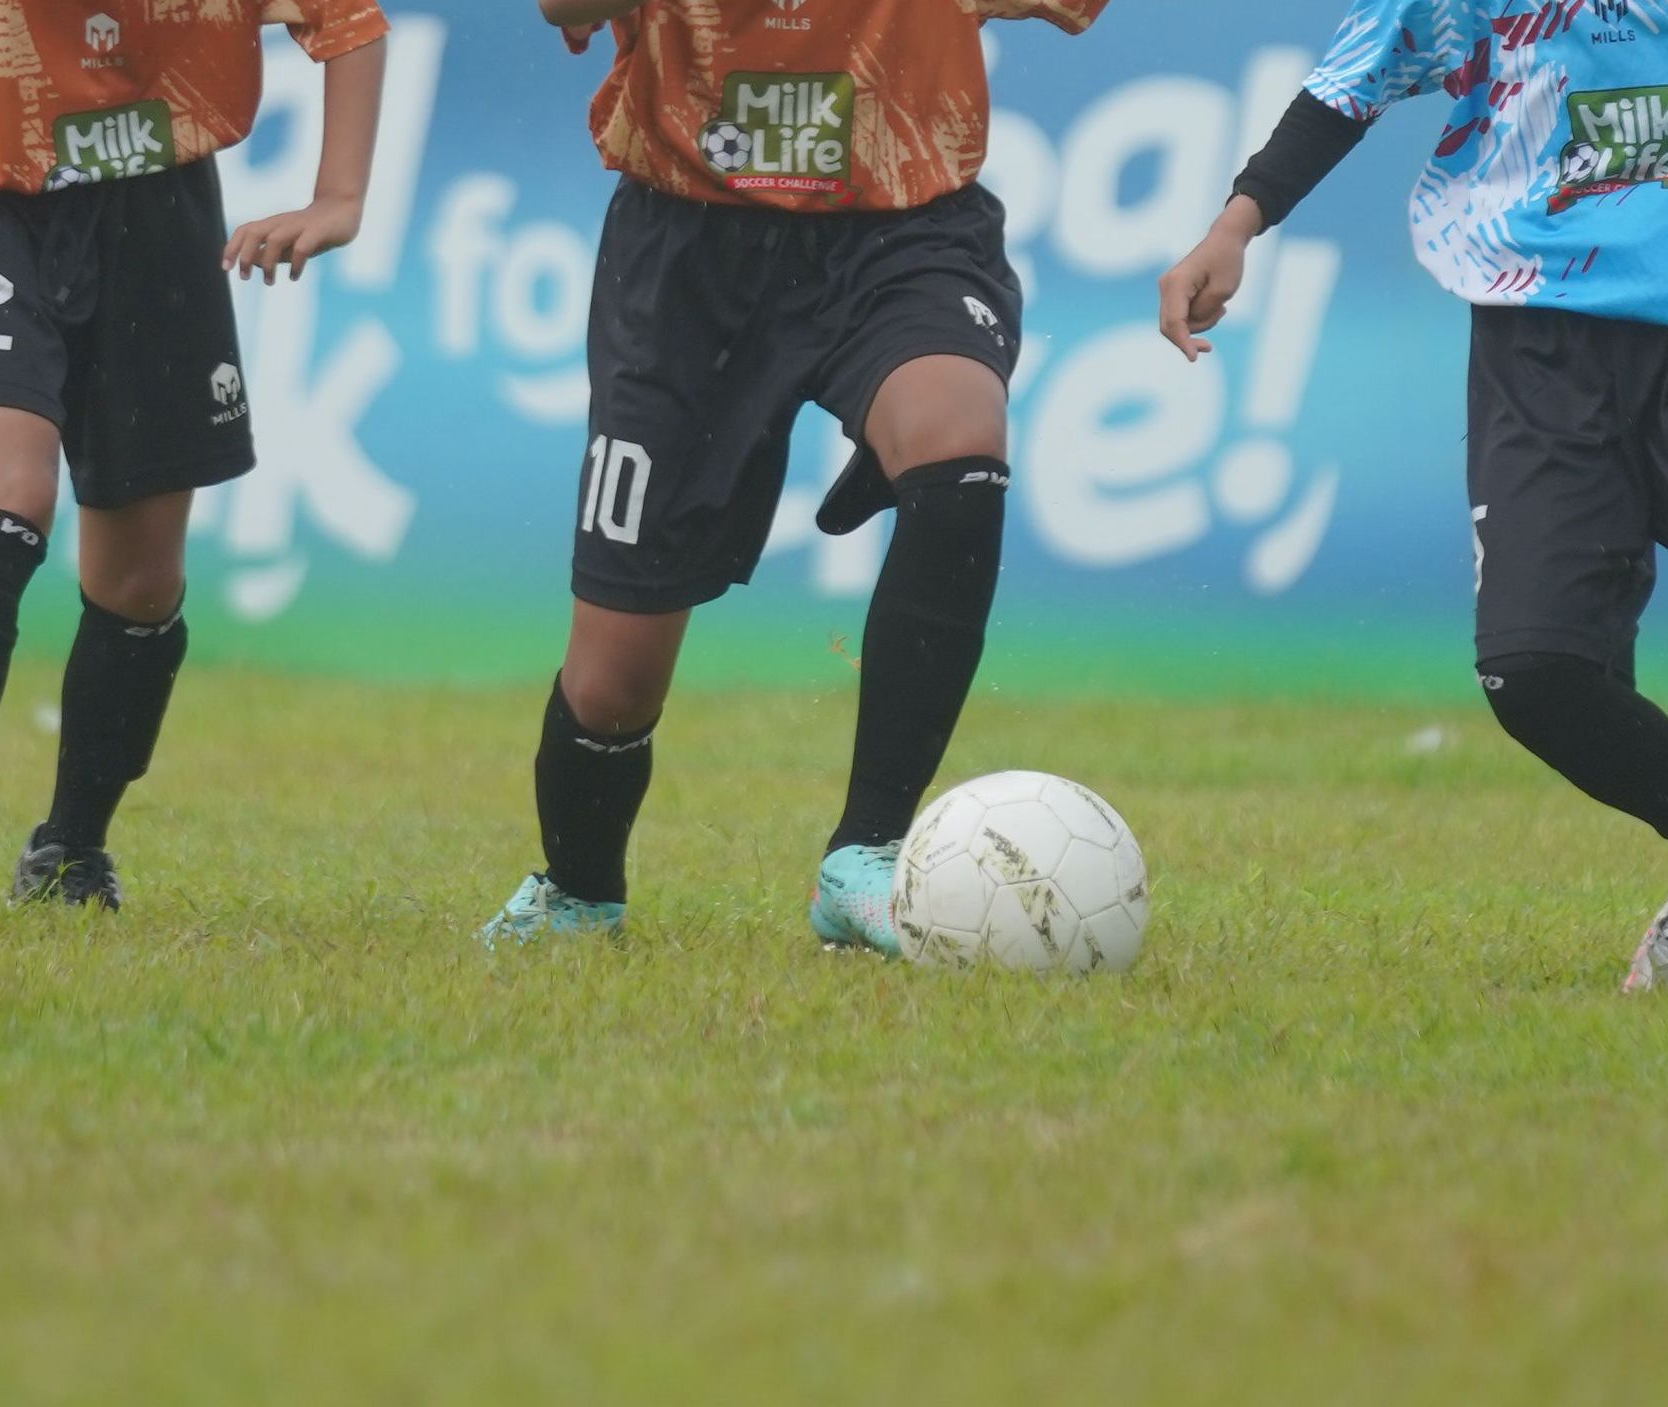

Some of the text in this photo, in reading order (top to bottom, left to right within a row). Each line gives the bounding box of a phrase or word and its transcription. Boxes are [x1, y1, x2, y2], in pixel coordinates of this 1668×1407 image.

[765, 17, 812, 31] MILLS
[1591, 29, 1636, 45] MILLS
[81, 56, 125, 70] MILLS
[736, 81, 843, 129] Milk
[65, 110, 164, 165] Milk
[752, 127, 844, 175] Life
[734, 177, 838, 192] SOCCER CHALLENGE
[210, 402, 248, 428] MILLS
[581, 433, 652, 545] 10
